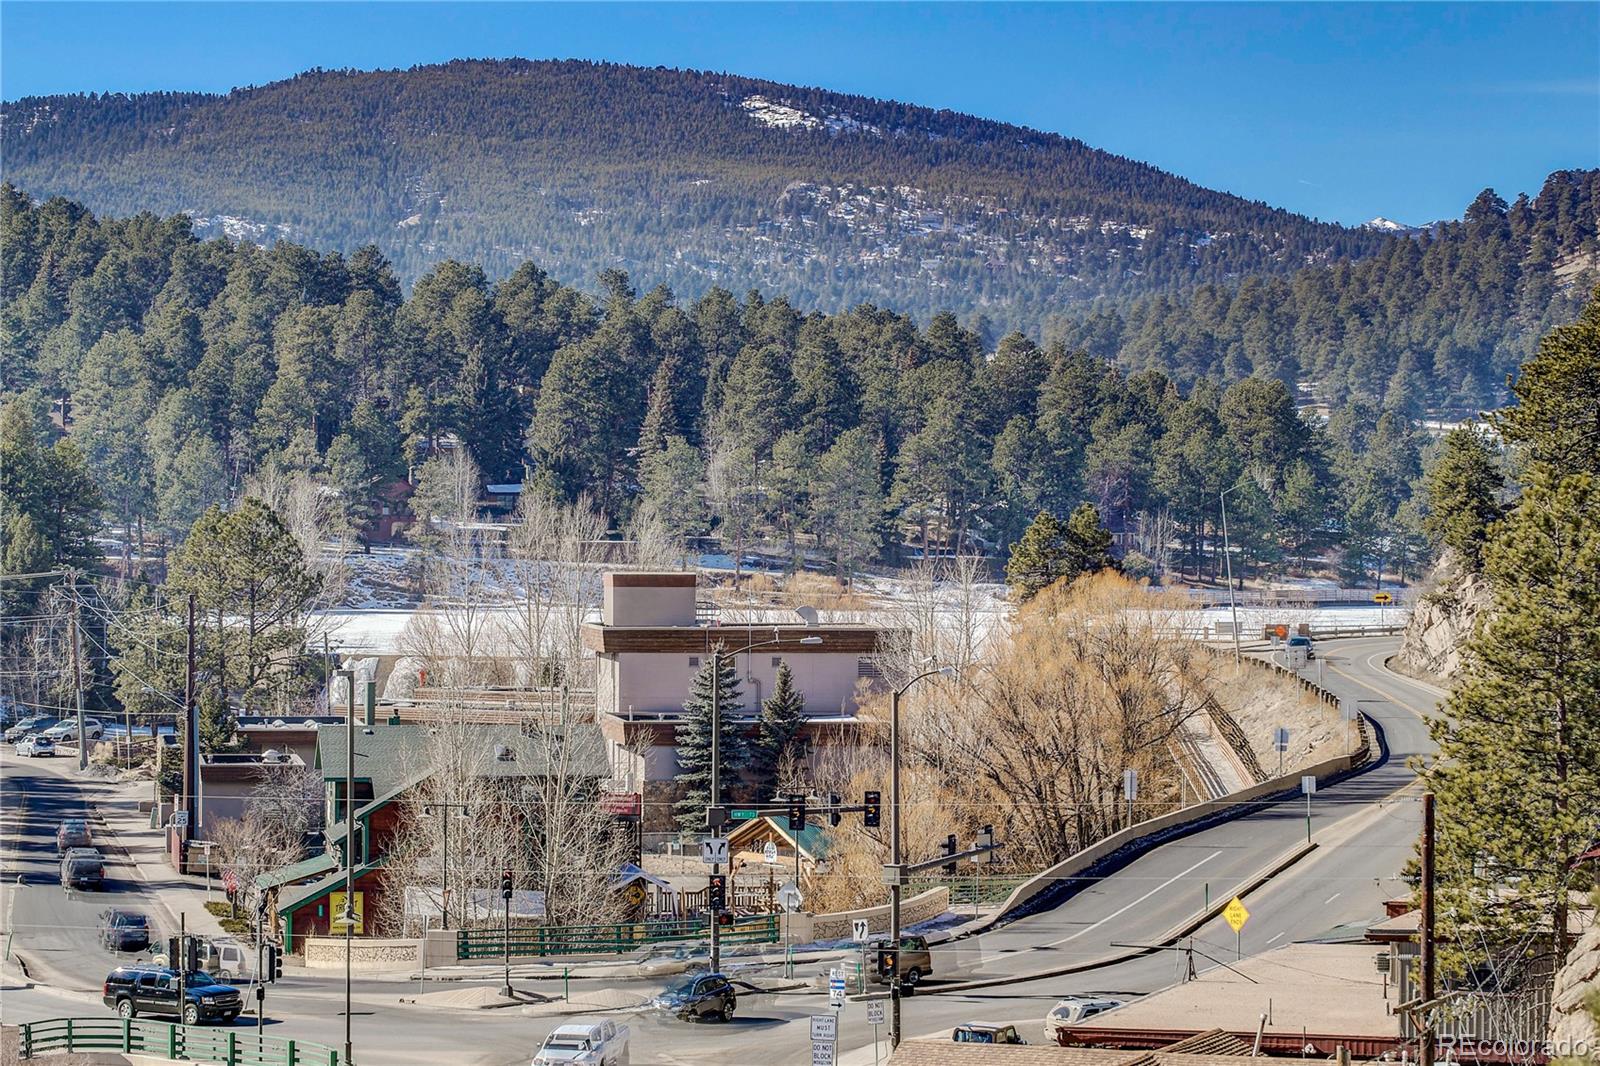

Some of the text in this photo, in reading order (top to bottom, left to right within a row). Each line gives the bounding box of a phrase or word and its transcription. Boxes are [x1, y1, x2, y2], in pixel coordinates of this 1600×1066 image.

[177, 817, 187, 825] 25
[832, 990, 842, 998] 74
[813, 1052, 831, 1060] BLOCK
